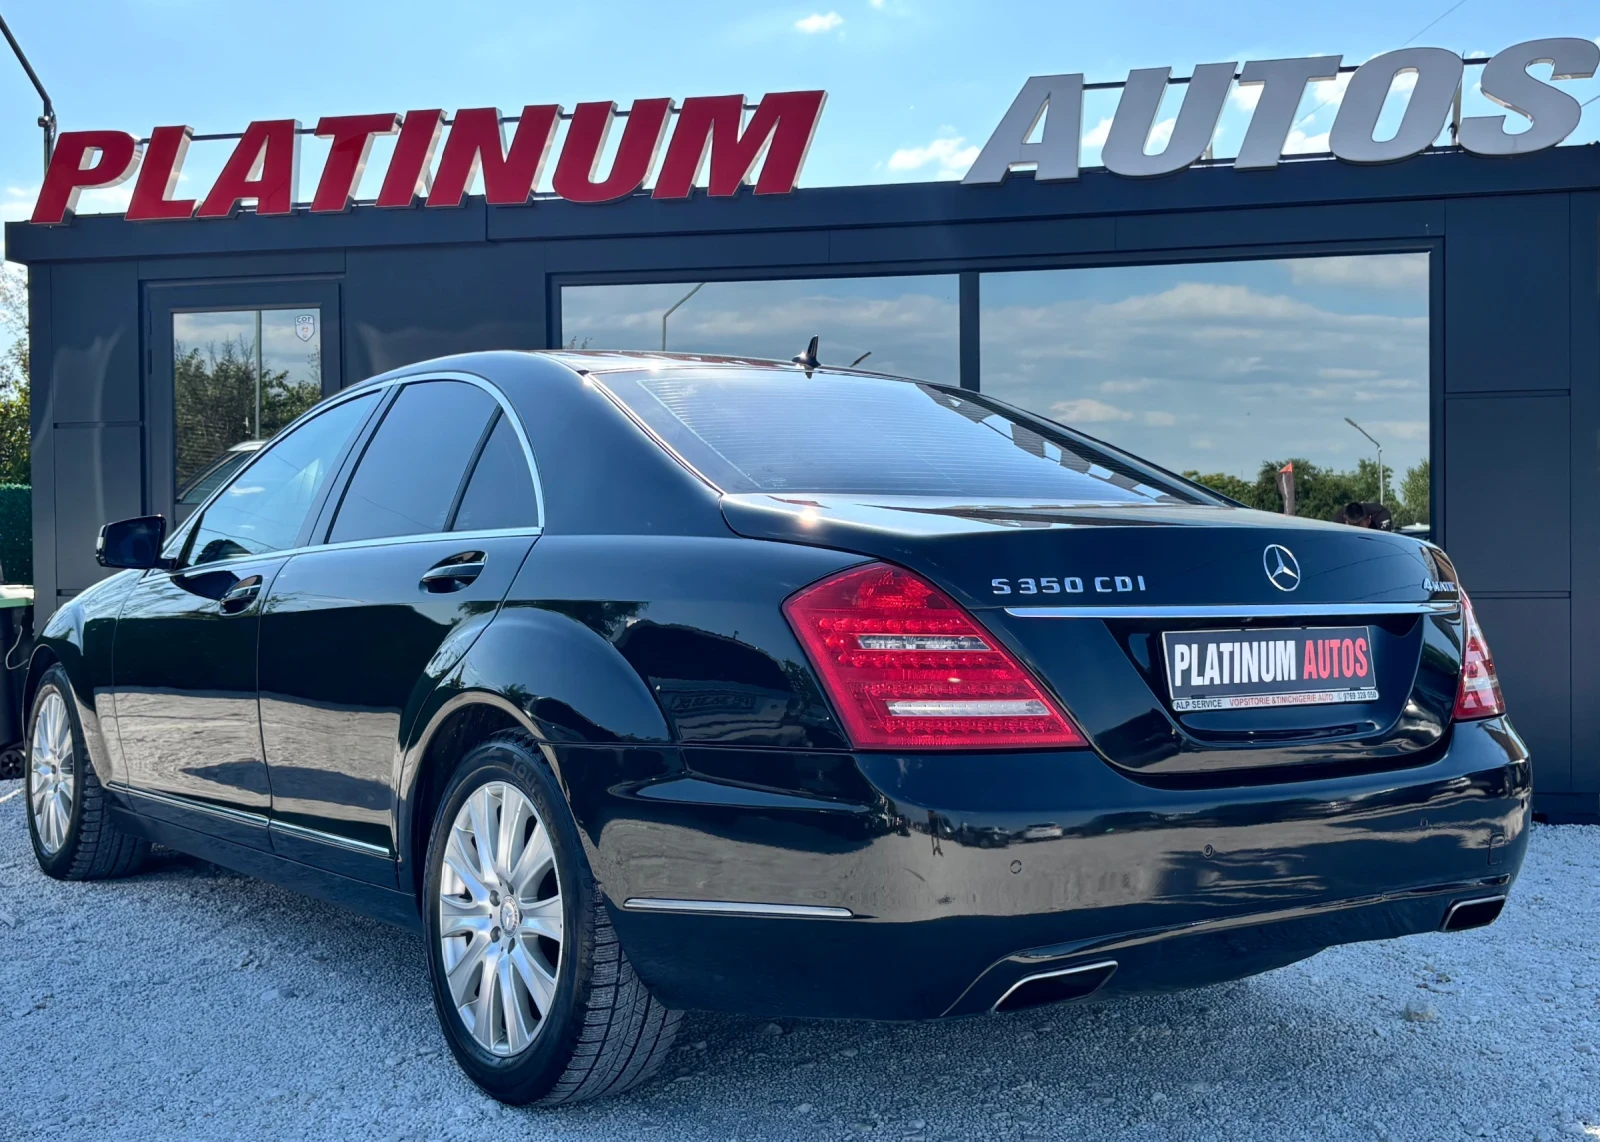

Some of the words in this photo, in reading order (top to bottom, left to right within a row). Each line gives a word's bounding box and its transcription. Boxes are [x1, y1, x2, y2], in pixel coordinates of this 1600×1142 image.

[961, 37, 1600, 185] AUTOS
[30, 90, 828, 227] PLATINUM
[991, 578, 1011, 594] S
[1017, 577, 1084, 594] 350
[1094, 575, 1146, 592] CDI
[1174, 640, 1297, 686] PLATINUM
[1303, 637, 1368, 680] AUTOS
[1175, 700, 1190, 709] ALP
[1192, 699, 1222, 709] SERVICE
[1229, 696, 1270, 706] VOPSITORIE
[1318, 693, 1334, 702] AUTO
